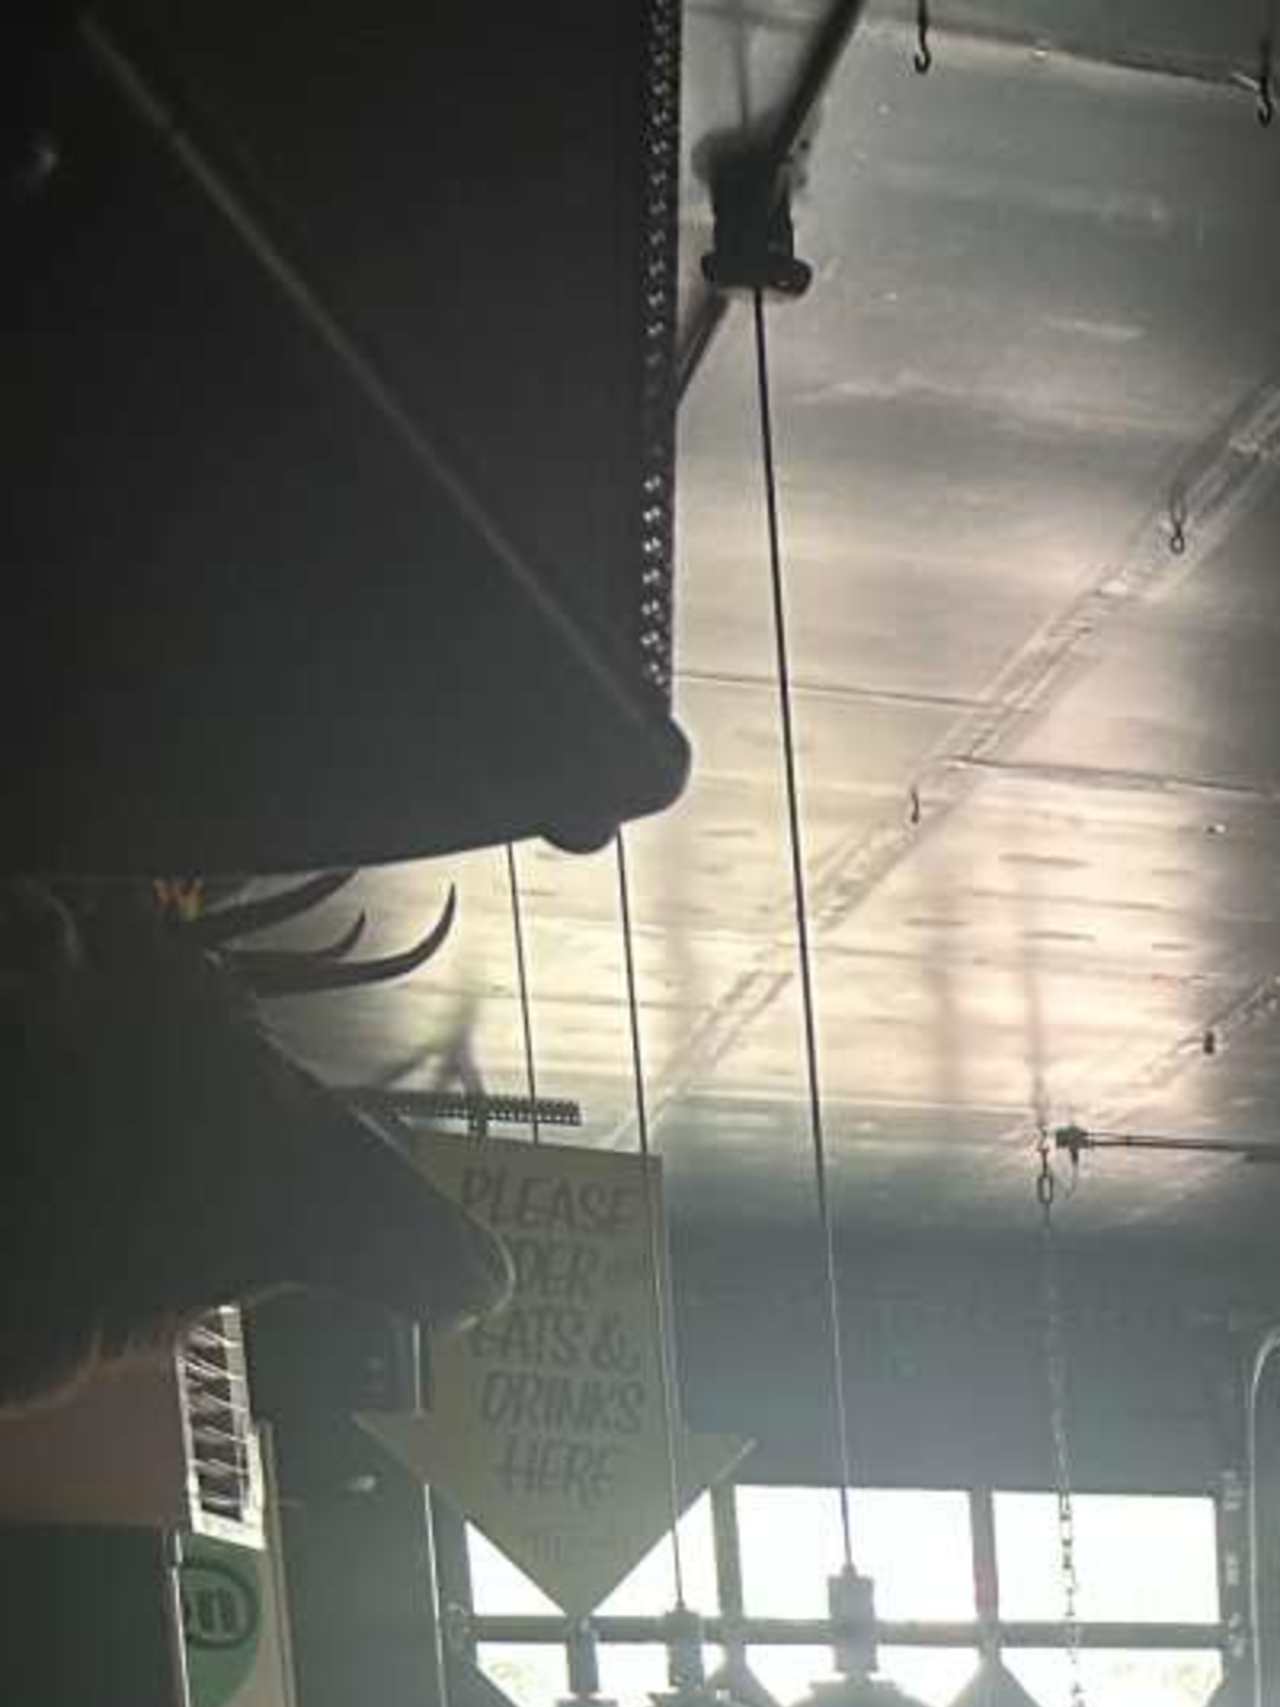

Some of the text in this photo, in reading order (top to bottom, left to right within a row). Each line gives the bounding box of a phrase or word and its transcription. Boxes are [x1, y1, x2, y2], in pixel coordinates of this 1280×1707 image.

[460, 1164, 641, 1235] PLEASE
[590, 1313, 639, 1373] &
[481, 1370, 646, 1434] DRINKS
[494, 1434, 617, 1509] HERE
